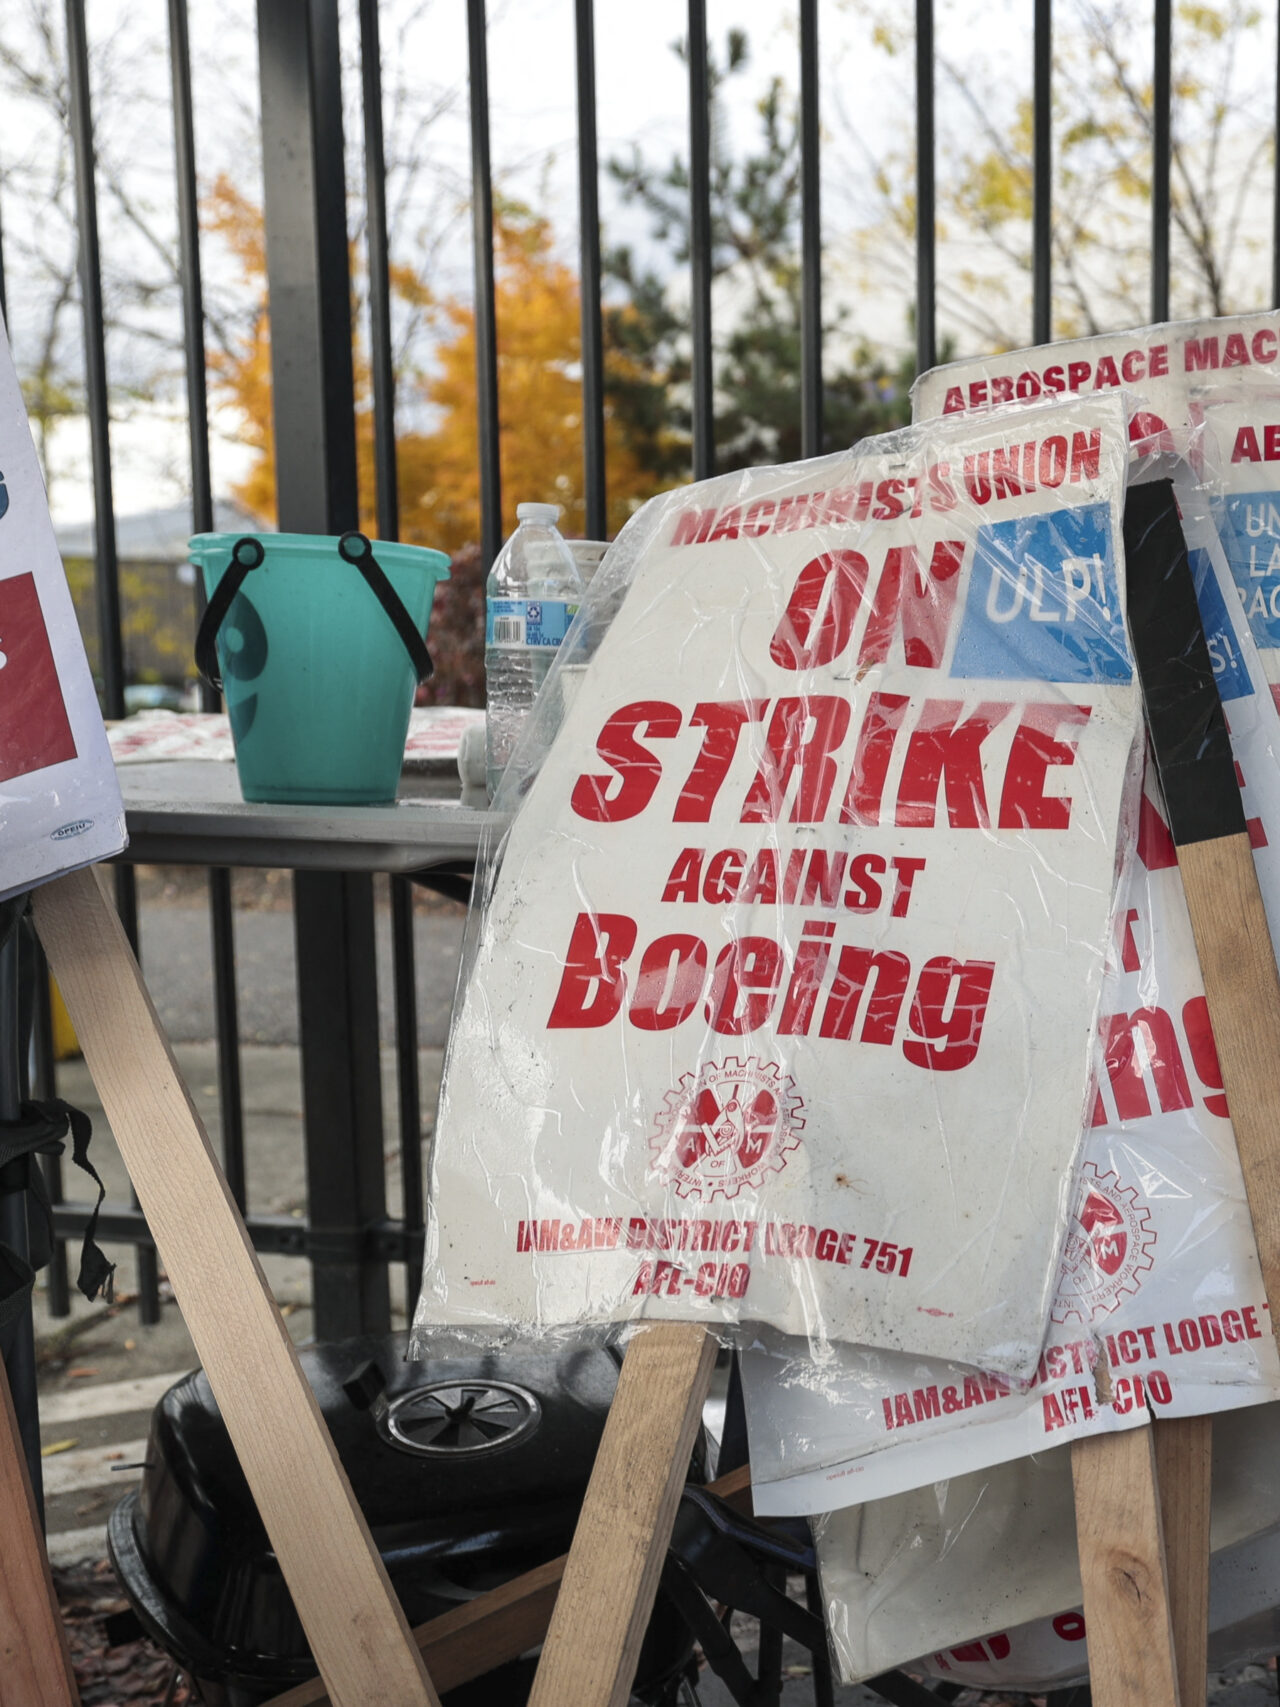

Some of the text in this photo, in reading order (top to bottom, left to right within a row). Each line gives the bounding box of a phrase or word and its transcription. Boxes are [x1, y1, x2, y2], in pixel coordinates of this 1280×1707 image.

[942, 344, 1169, 416] AEROSPACE
[963, 428, 1103, 512] UNION
[768, 541, 966, 671] ON
[985, 553, 1113, 623] ULP!
[570, 691, 1092, 830] STRIKE
[661, 848, 926, 918] AGAINST
[546, 912, 995, 1071] Boeing
[516, 1217, 913, 1278] IAM&AW DISTRICT LODGE 751
[632, 1260, 750, 1298] AFL-CIO
[1163, 1306, 1261, 1354] LODGE
